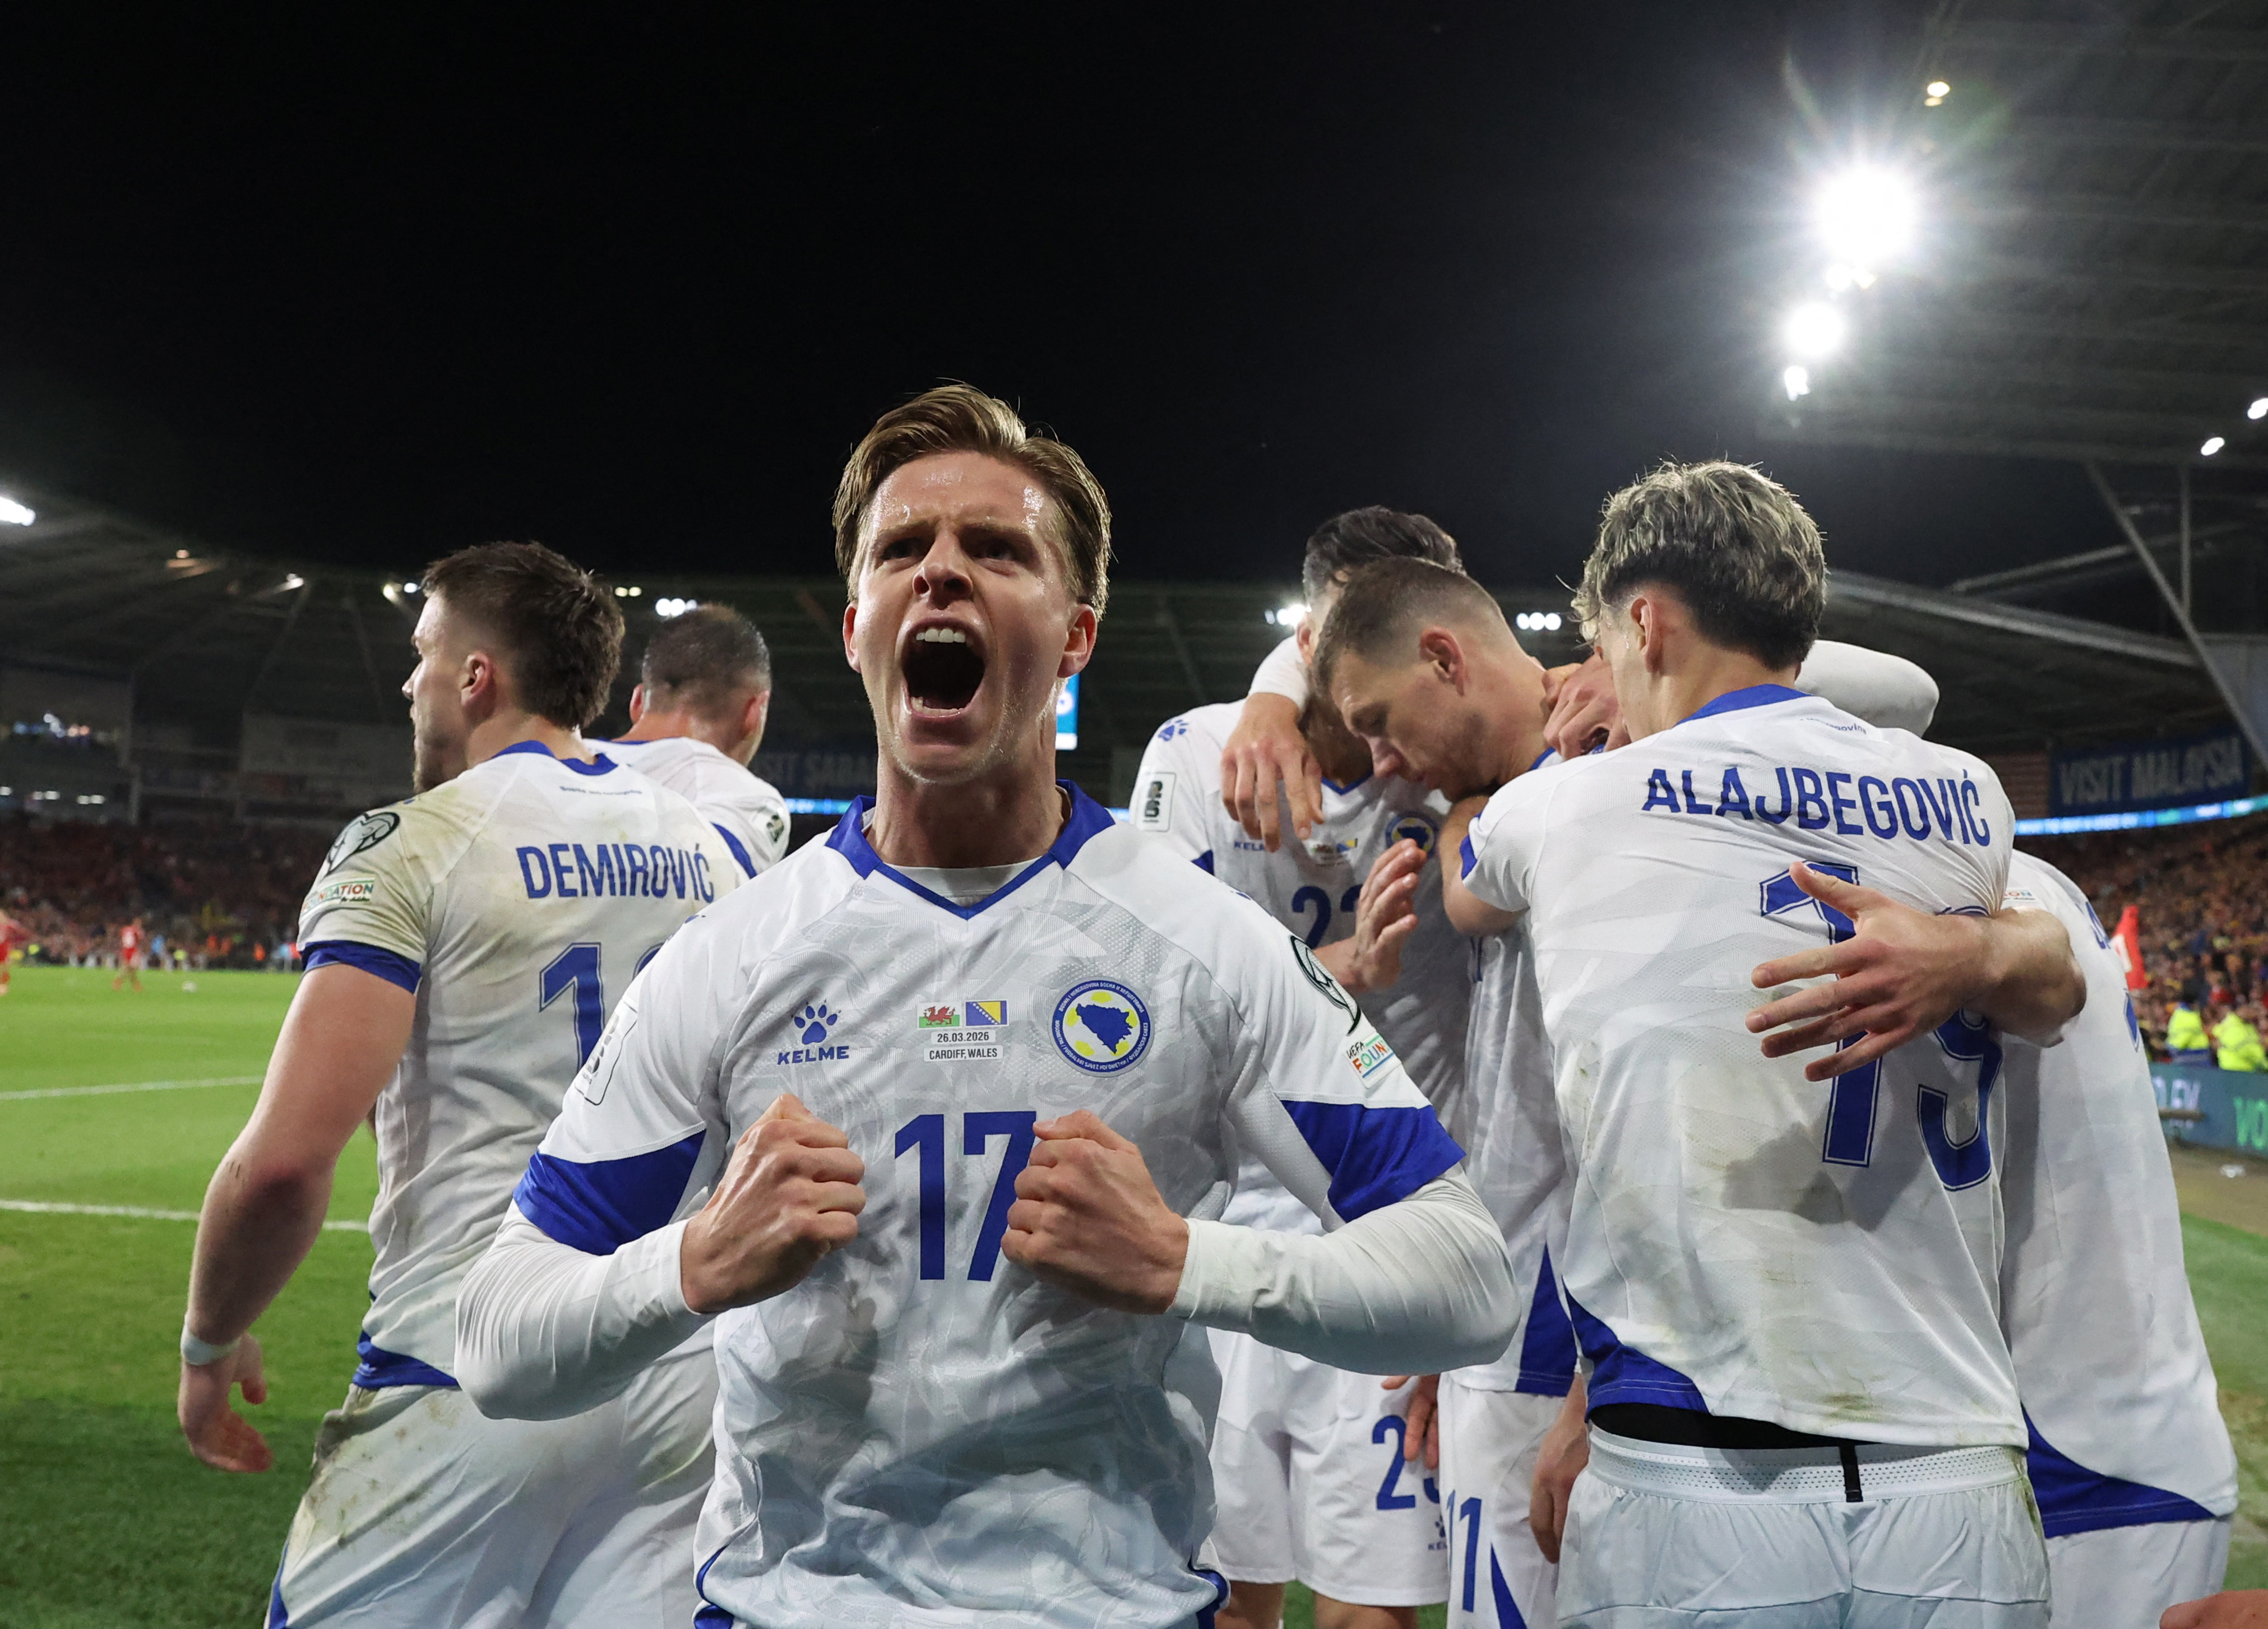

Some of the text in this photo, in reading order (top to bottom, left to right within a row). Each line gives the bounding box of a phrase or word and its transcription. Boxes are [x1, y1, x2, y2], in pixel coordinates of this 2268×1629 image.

[2060, 756, 2125, 805] VISIT
[1642, 767, 1991, 847] ALAJBEGOVIĆ
[516, 843, 715, 904] DEMIROVIĆ
[937, 1031, 989, 1043] 26.03.2026
[1346, 1042, 1364, 1059] UEFA
[777, 1045, 850, 1065] KELME
[929, 1048, 998, 1060] CARDIFF, WALES
[1352, 1040, 1390, 1070] FOUN
[894, 1110, 1037, 1281] 17
